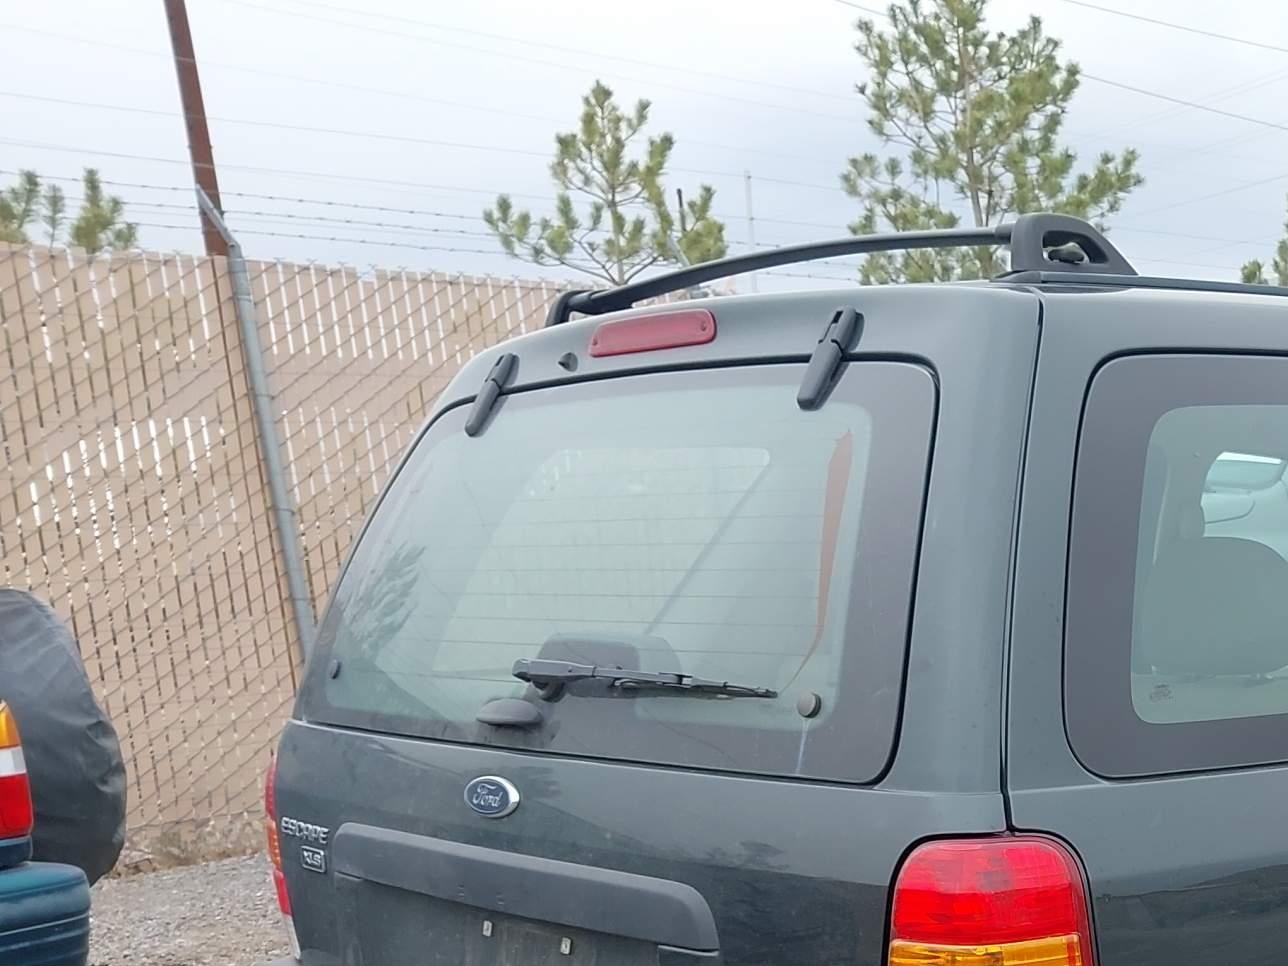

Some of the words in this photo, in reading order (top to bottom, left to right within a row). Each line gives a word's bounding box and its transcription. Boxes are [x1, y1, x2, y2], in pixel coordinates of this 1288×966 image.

[472, 783, 504, 808] Ford
[280, 816, 330, 845] ESCAPE
[302, 850, 323, 867] XLS
